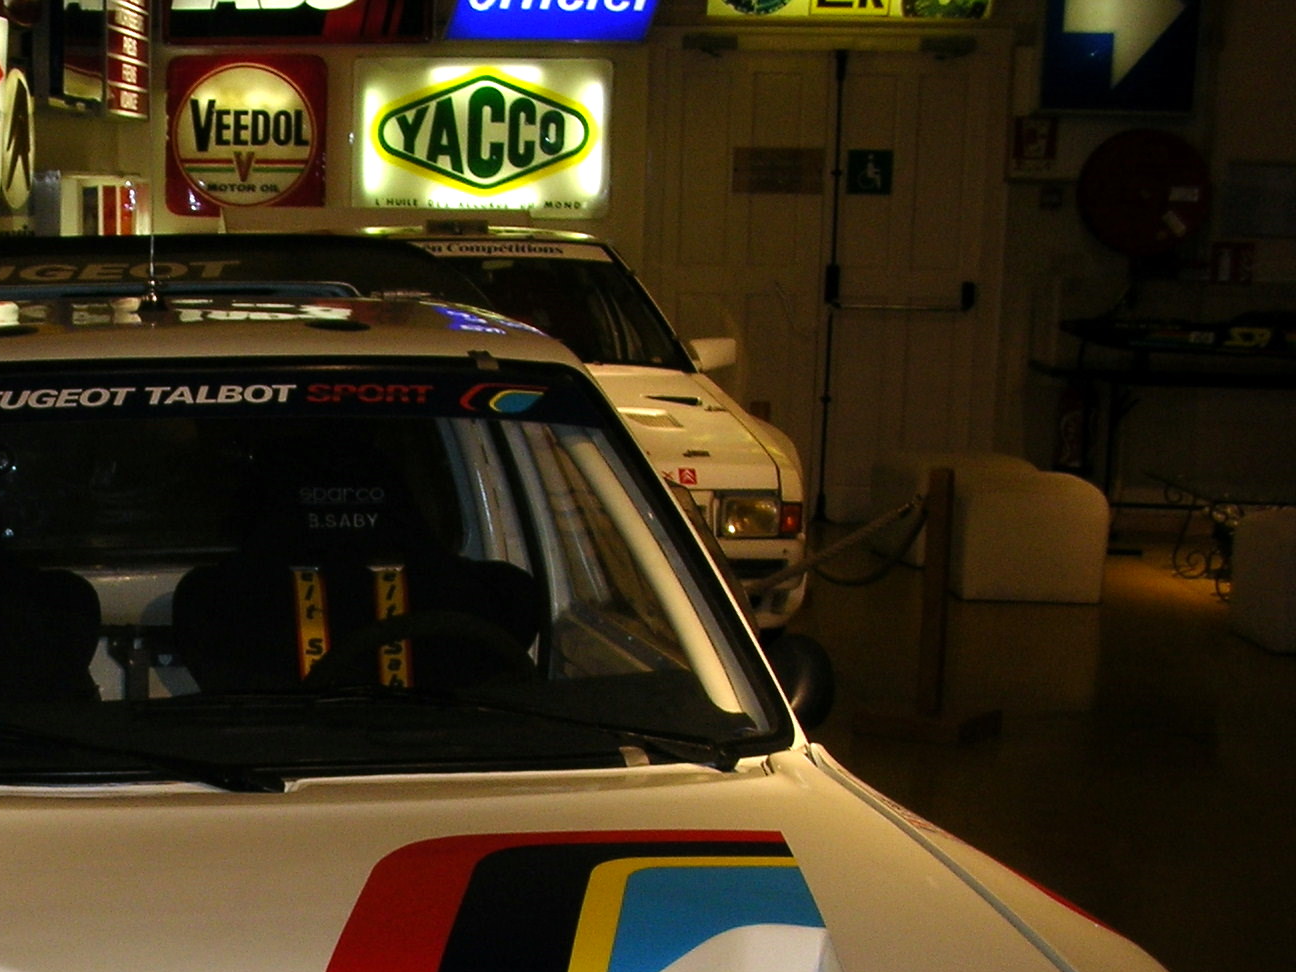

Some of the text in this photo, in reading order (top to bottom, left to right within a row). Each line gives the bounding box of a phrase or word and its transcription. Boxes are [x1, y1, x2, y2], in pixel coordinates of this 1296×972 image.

[190, 98, 309, 152] VEEDOL
[395, 86, 565, 179] YACCO
[207, 183, 280, 194] MOTOR OIL
[144, 383, 296, 406] TALBOT
[306, 384, 435, 404] SPORT
[299, 486, 385, 505] sparco
[308, 512, 379, 529] B.SABY
